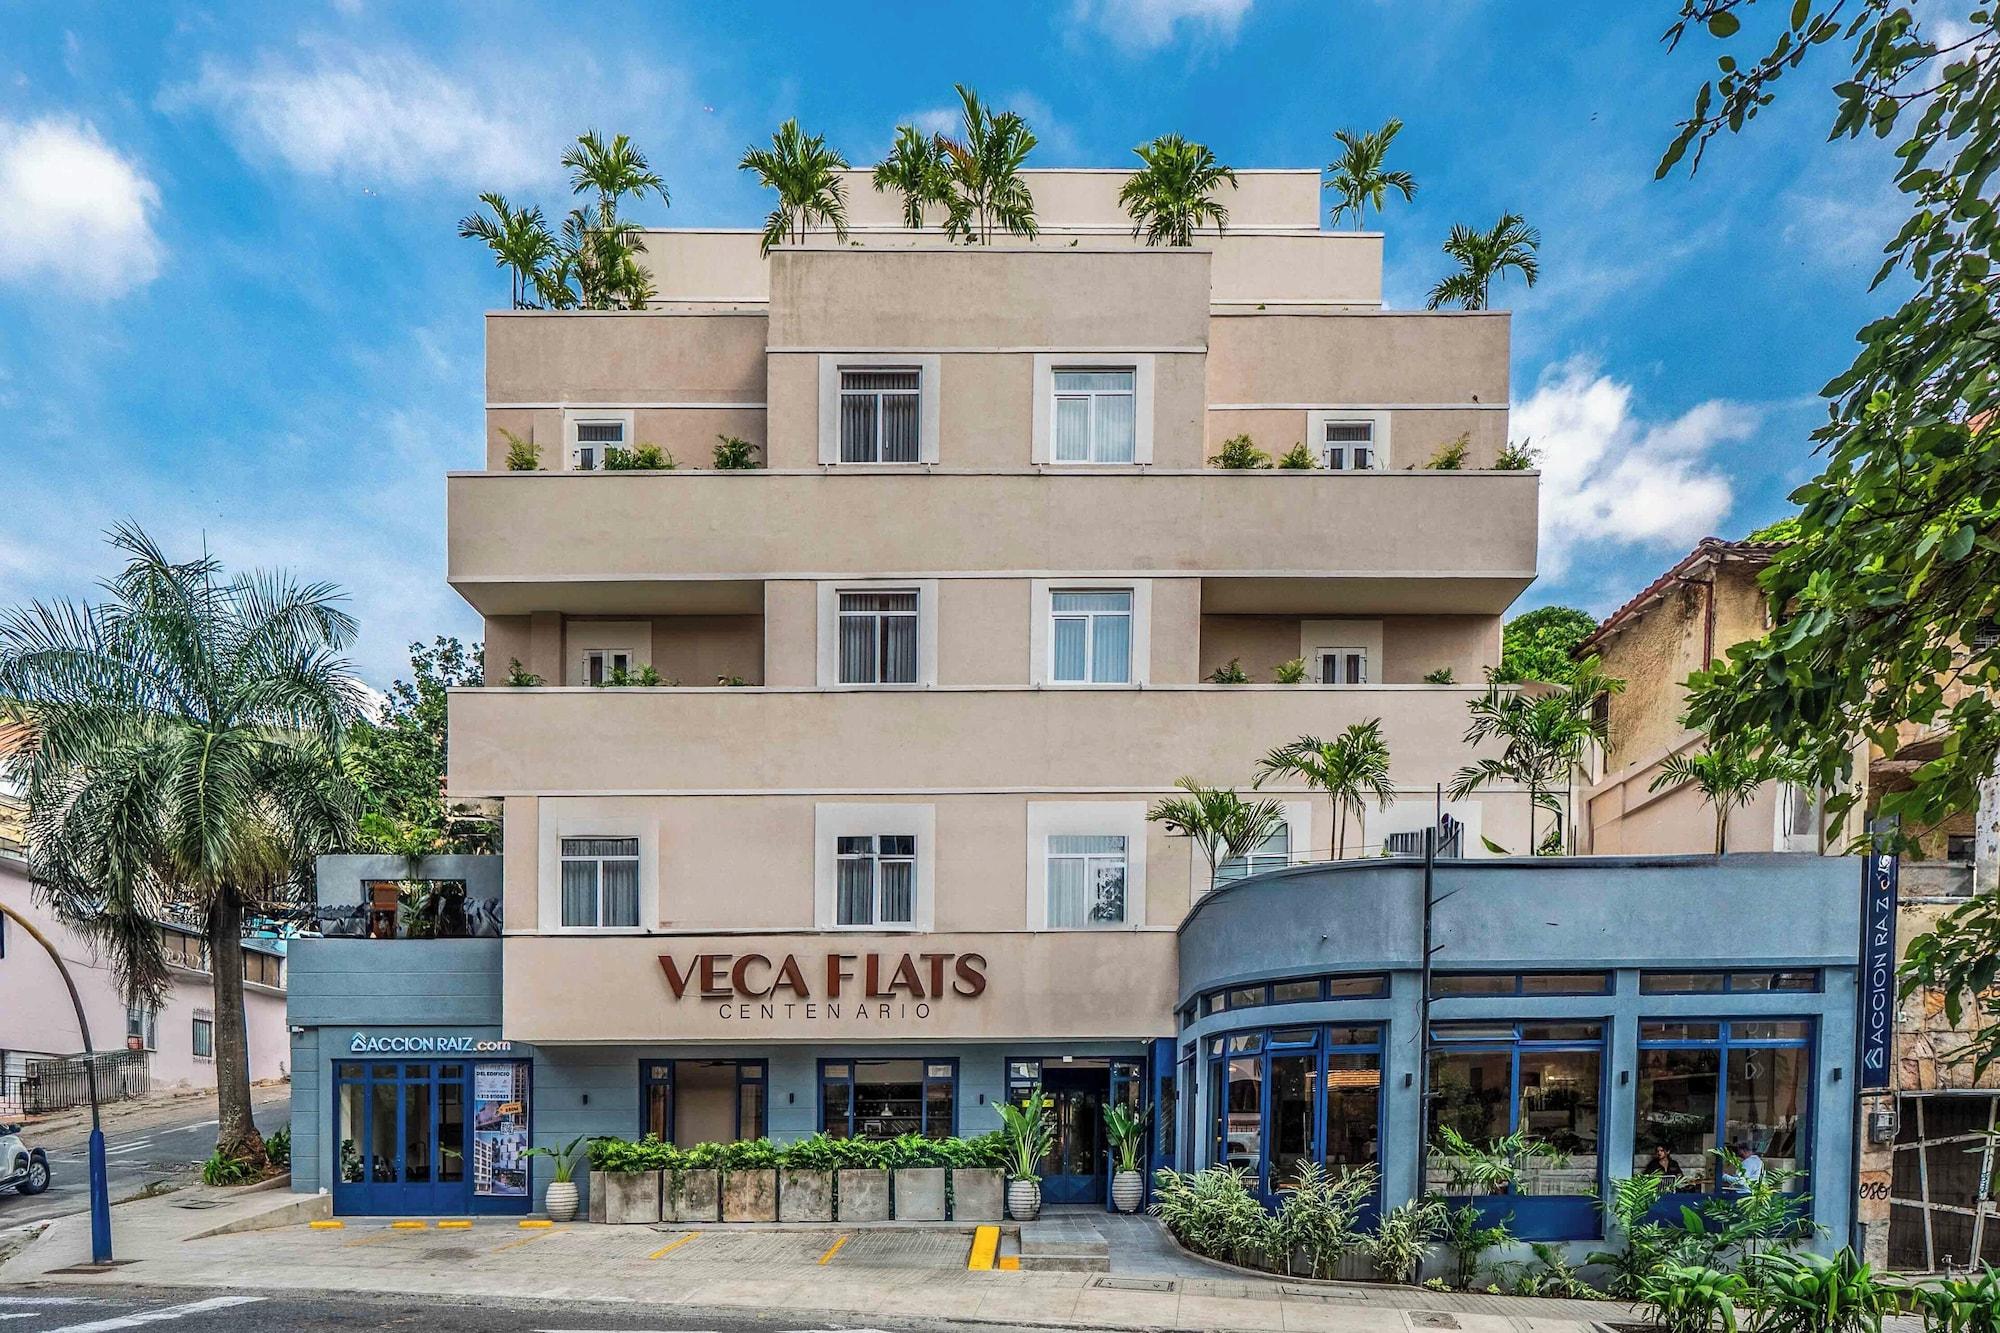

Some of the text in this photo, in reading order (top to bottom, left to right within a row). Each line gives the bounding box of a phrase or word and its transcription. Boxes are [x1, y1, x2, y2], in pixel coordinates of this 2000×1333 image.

[658, 953, 988, 999] VECA FLATS
[719, 1003, 930, 1019] CENTENARIO
[1872, 953, 1888, 1044] ACCION
[367, 1036, 434, 1051] ACCION
